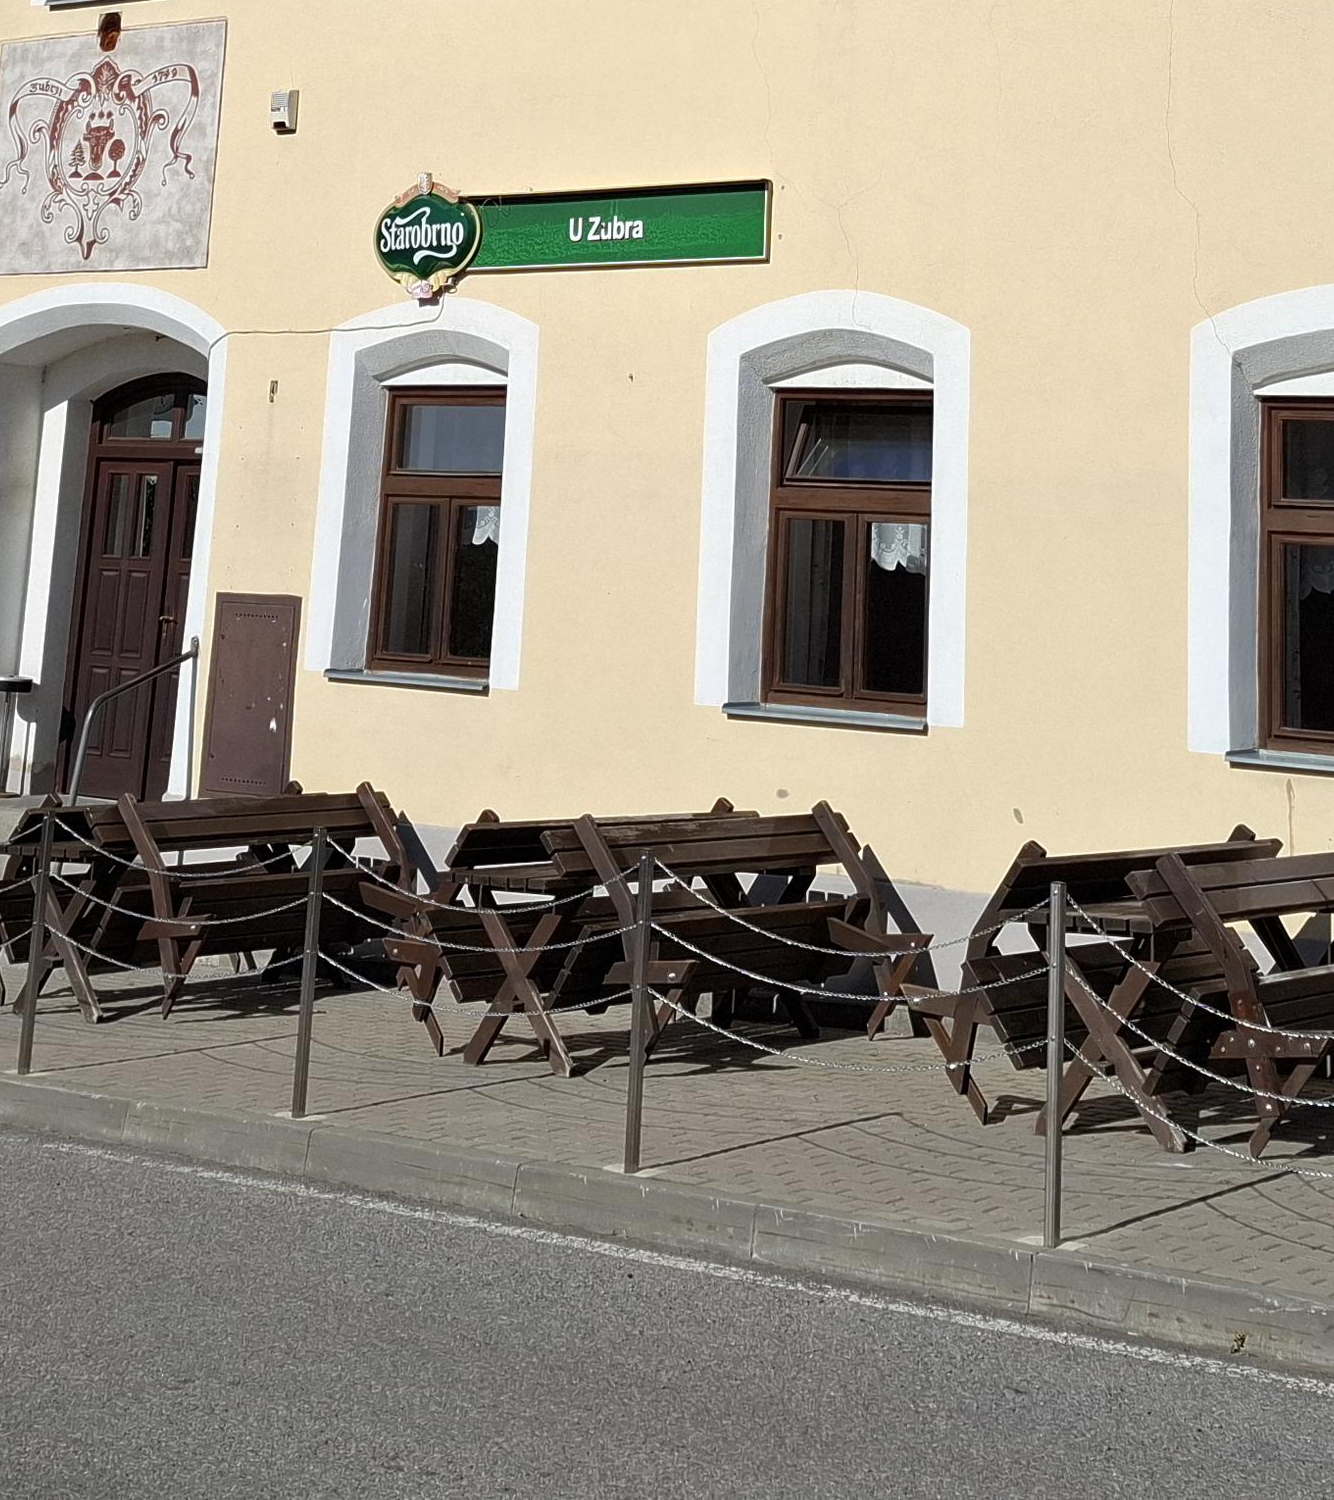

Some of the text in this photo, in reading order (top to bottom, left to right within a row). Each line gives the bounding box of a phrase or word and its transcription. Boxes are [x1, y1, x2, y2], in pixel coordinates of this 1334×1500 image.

[380, 206, 464, 265] Starobrno
[569, 216, 644, 241] U Zubra
